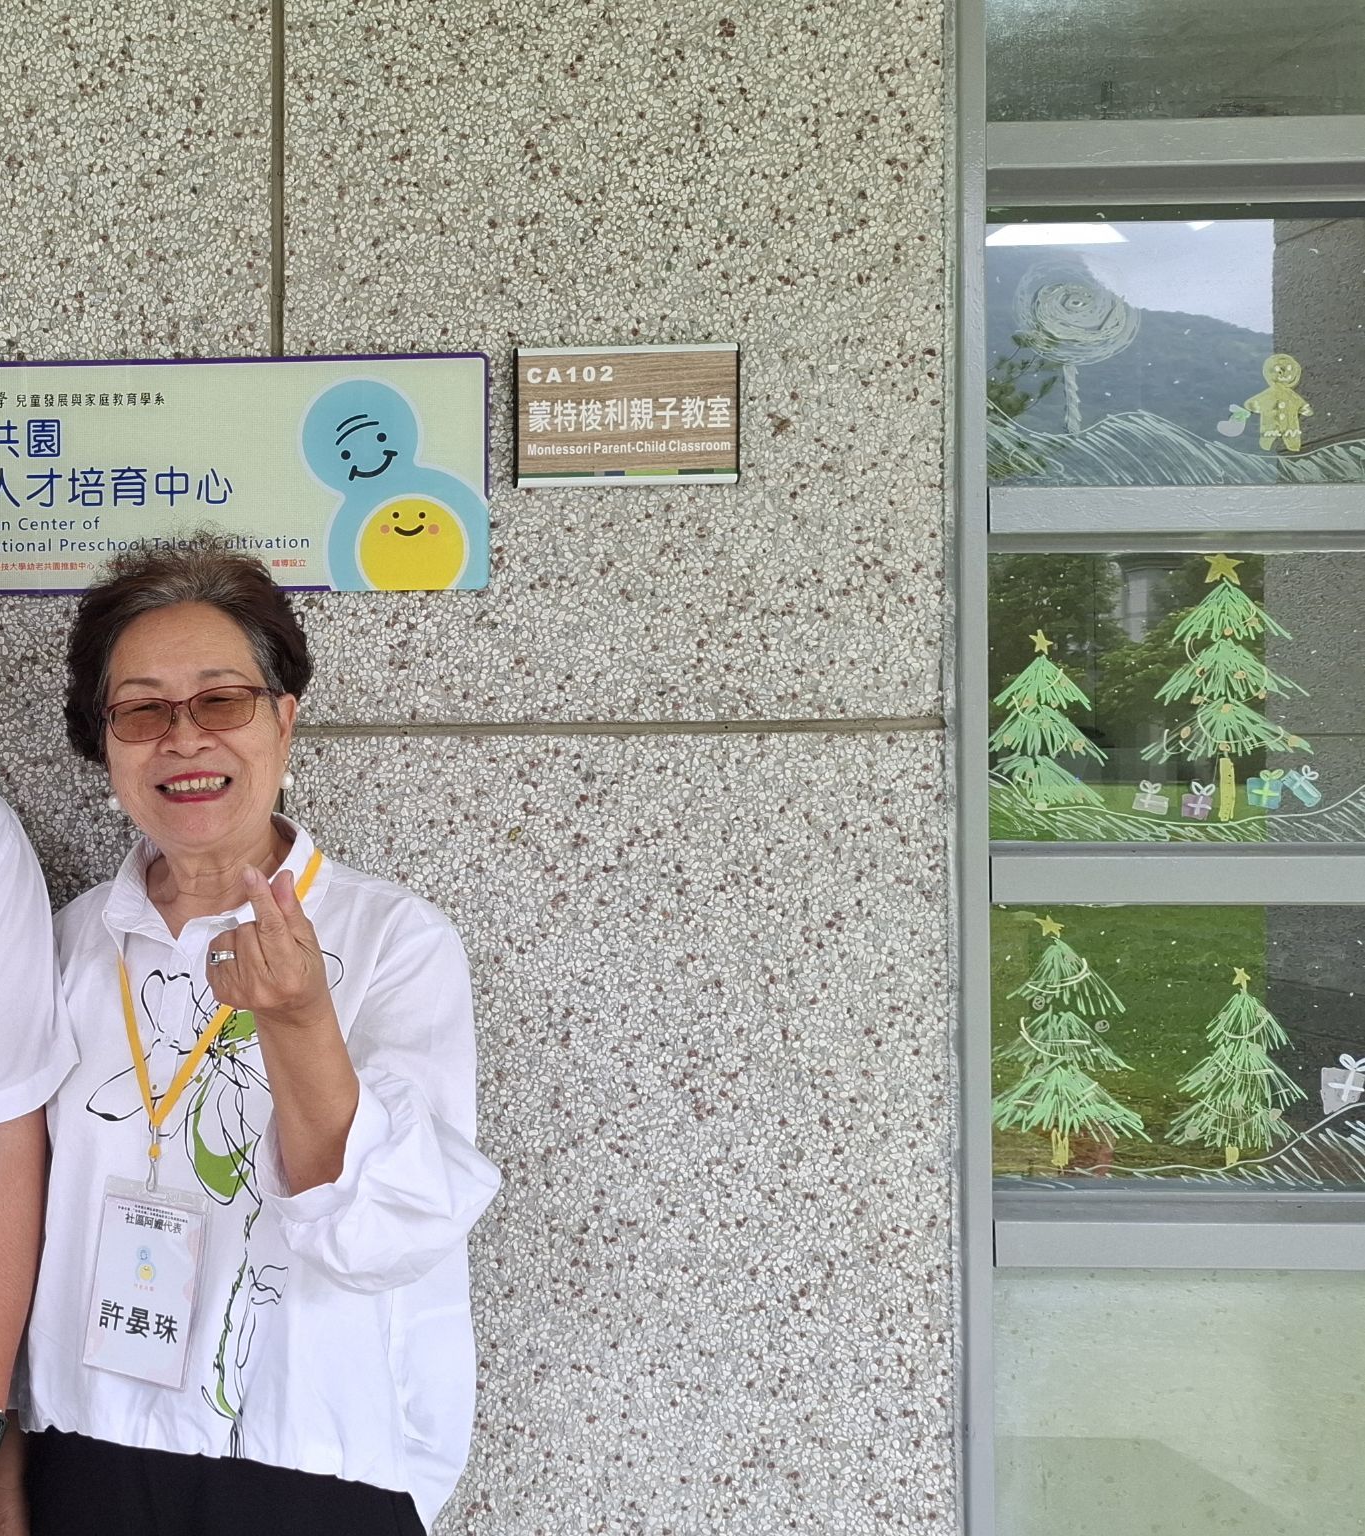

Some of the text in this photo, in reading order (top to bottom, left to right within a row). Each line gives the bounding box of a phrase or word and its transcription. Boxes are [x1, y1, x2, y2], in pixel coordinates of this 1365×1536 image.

[526, 365, 614, 384] CA102
[16, 392, 165, 408] 兒童發展與家庭教育學系
[528, 395, 731, 433] 蒙特梭利親子教室
[527, 439, 731, 456] Montessori Parent-Child Classroom
[18, 517, 75, 531] Center
[82, 516, 100, 530] of
[60, 537, 146, 552] Preschool
[213, 535, 310, 550] Cultivation
[124, 1211, 182, 1235] 社區阿嬤代表
[99, 1298, 178, 1344] 許晏珠
